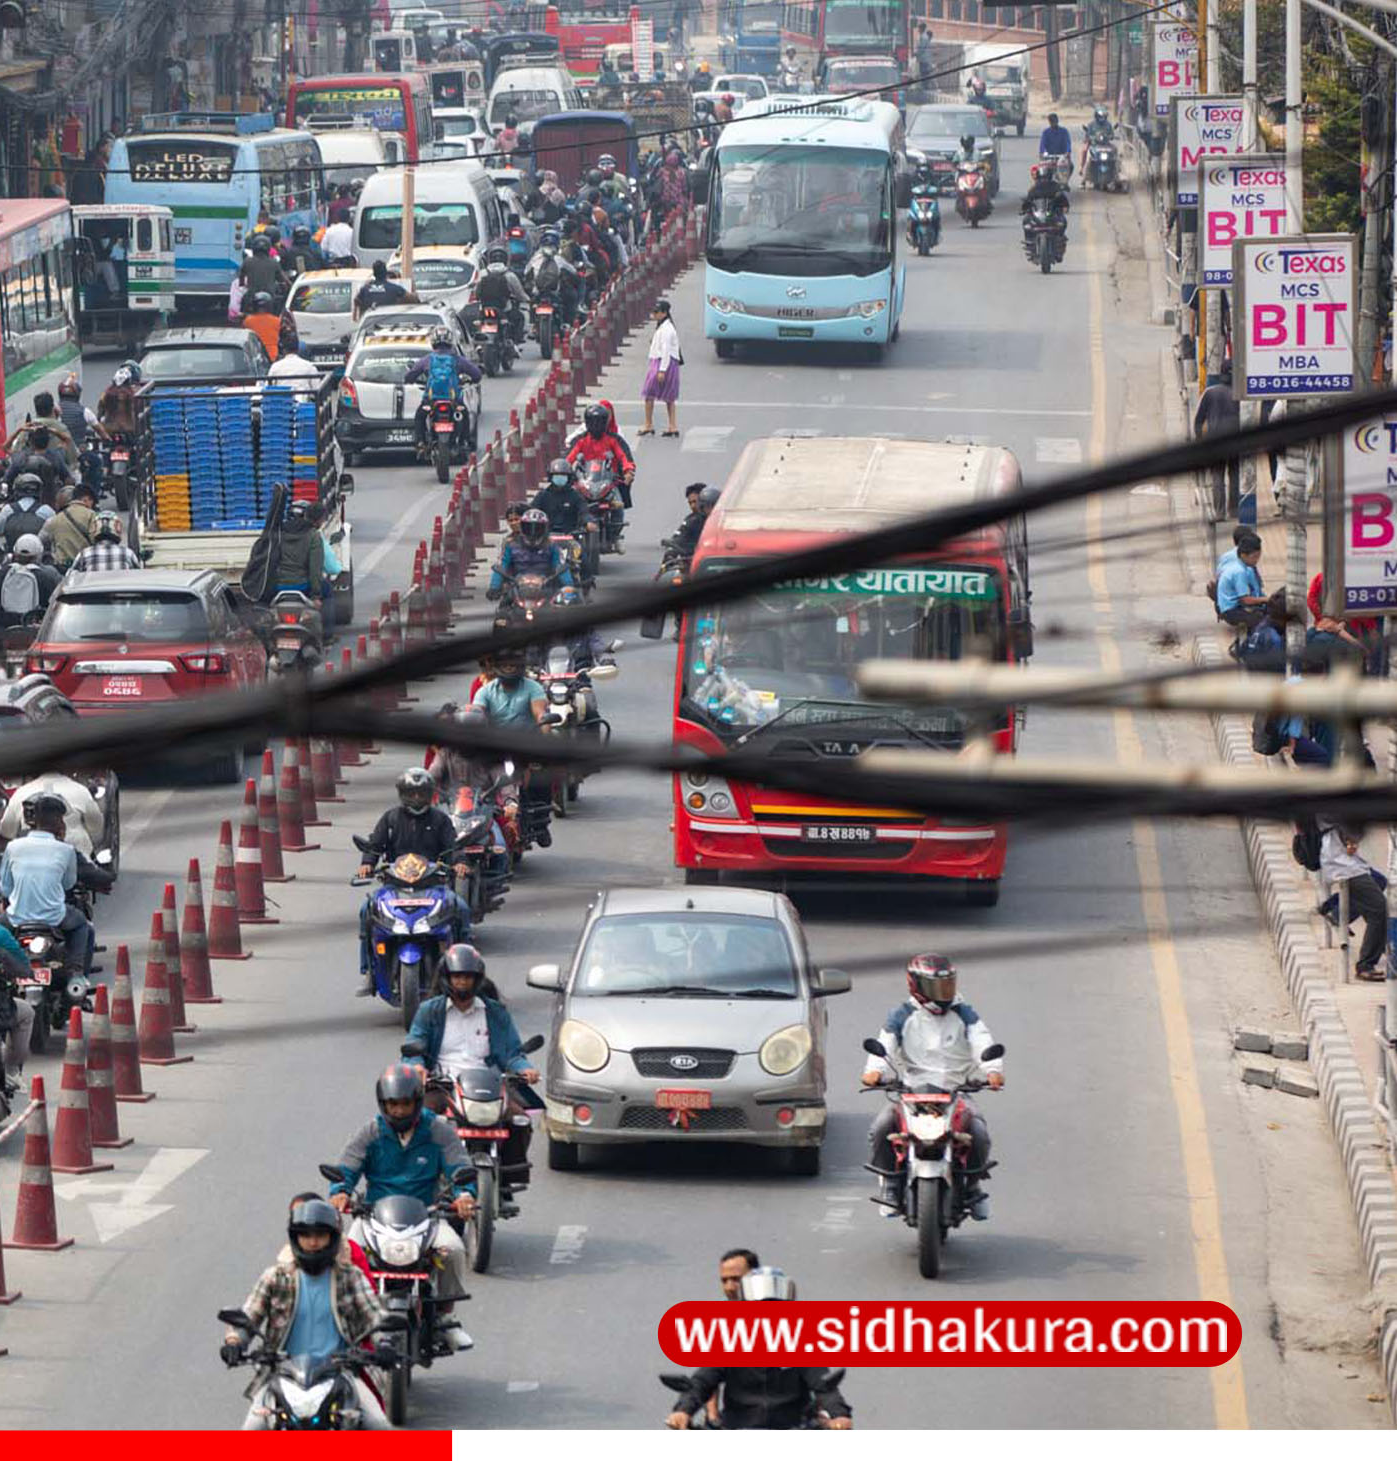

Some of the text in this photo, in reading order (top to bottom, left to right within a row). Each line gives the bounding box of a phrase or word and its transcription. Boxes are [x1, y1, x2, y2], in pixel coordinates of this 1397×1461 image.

[1202, 129, 1231, 140] MCS
[164, 153, 203, 163] LED
[135, 164, 228, 180] DELUXE
[1229, 166, 1287, 187] Texas
[1231, 194, 1265, 206] MCS
[1207, 209, 1287, 246] BIT
[1277, 250, 1346, 274] Texas
[1281, 284, 1319, 297] MCS
[1252, 303, 1348, 347] BIT
[1279, 356, 1320, 369] MBA
[1249, 377, 1350, 388] 98-016-44458
[855, 569, 989, 595] यातायात
